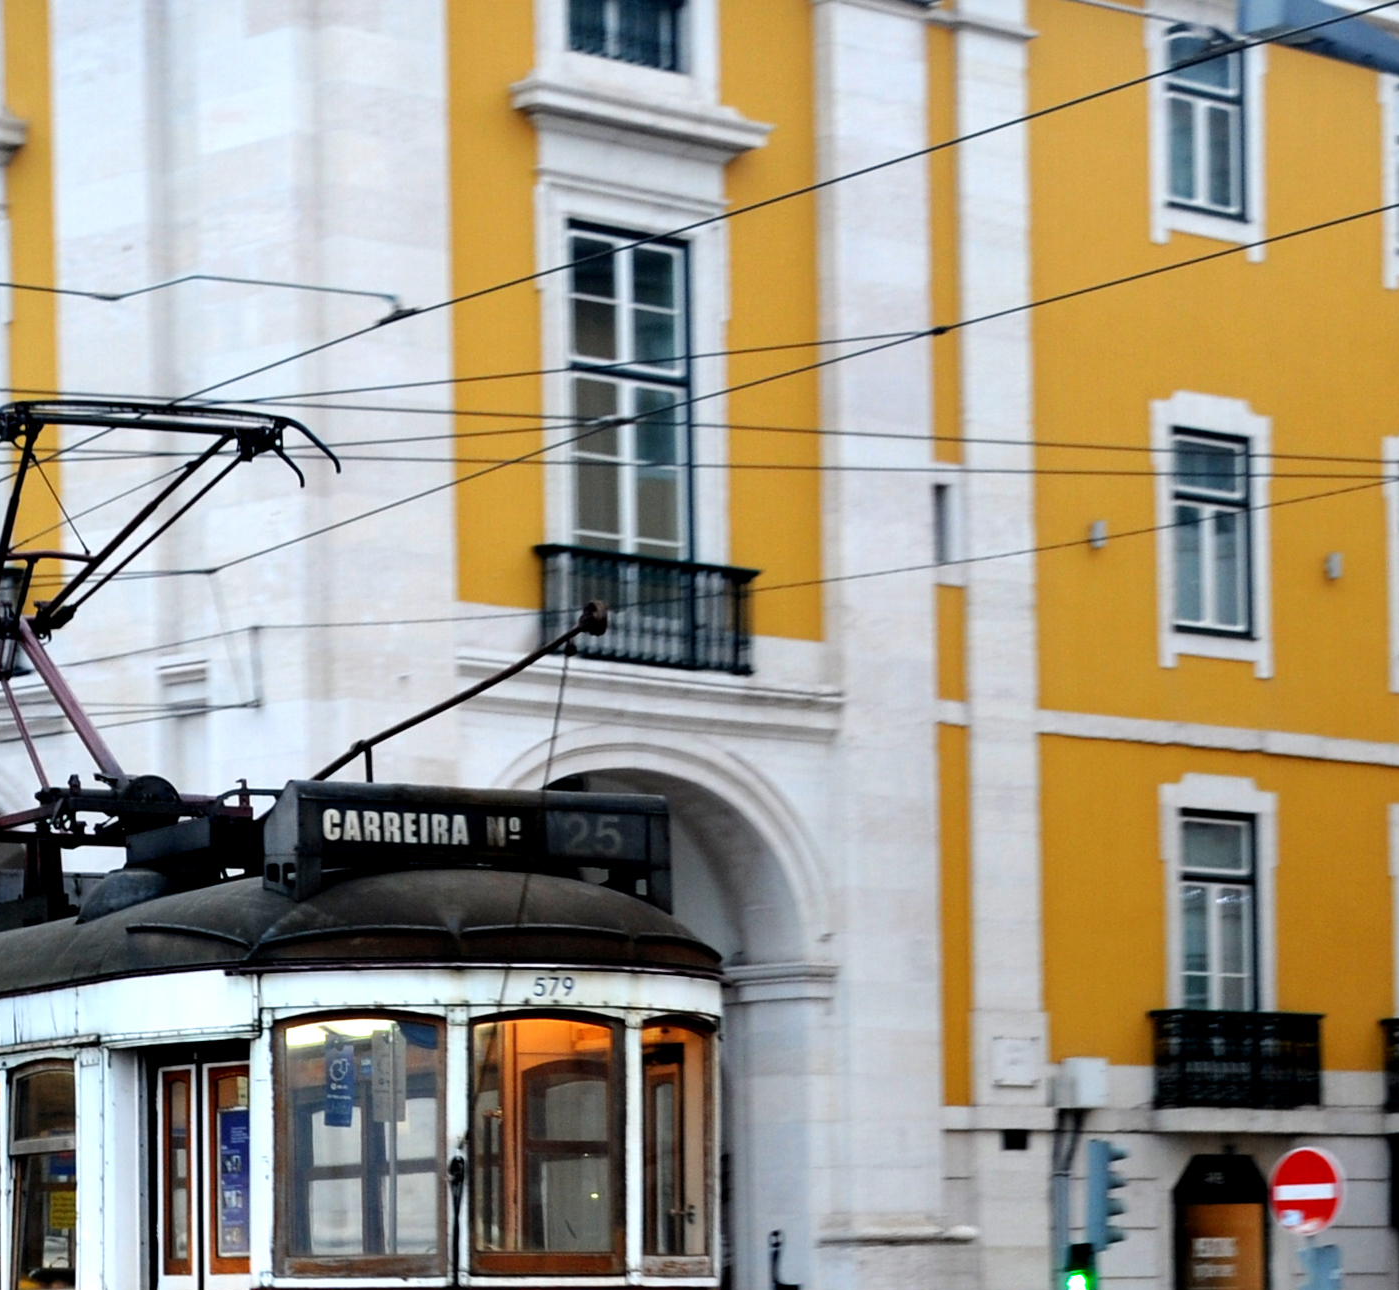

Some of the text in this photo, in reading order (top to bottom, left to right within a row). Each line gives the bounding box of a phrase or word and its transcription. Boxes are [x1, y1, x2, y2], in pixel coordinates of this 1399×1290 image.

[322, 808, 470, 845] CARREIRA
[565, 814, 624, 855] 25
[533, 976, 576, 997] 579
